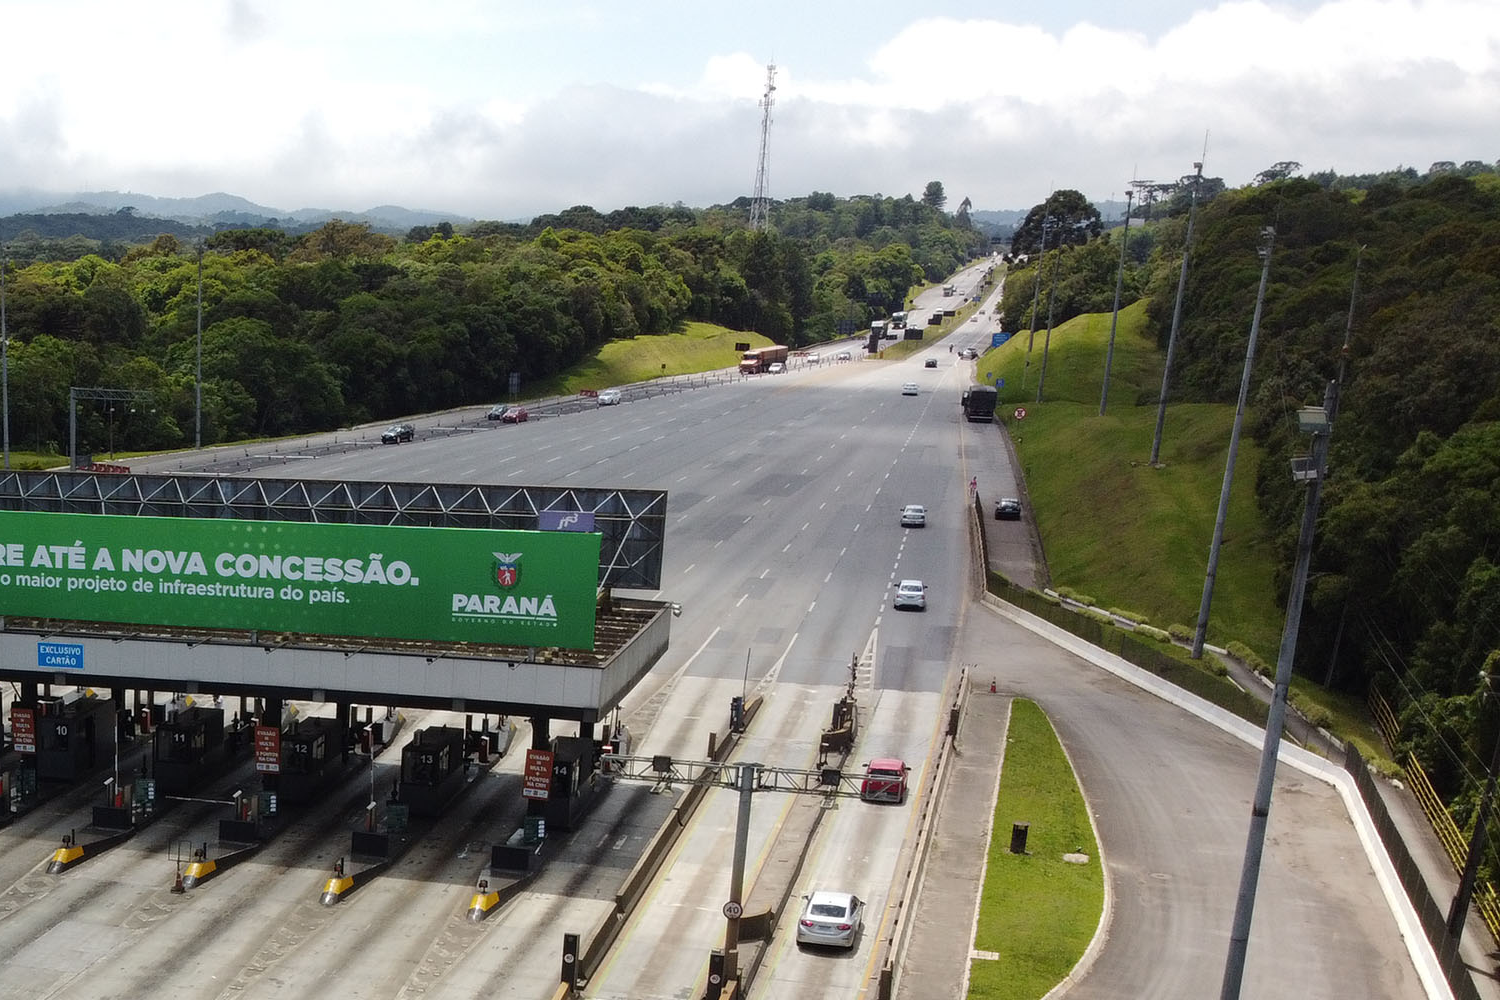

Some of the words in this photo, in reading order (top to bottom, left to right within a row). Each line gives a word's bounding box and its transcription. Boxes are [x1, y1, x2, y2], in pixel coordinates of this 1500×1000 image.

[31, 540, 85, 569] ATÉ
[92, 548, 115, 570] A
[122, 549, 207, 575] NOVA
[215, 553, 419, 585] CONCESSÃO.
[1, 574, 11, 585] o
[16, 572, 62, 588] maior
[68, 576, 127, 592] projeto
[132, 577, 153, 592] de
[159, 578, 274, 599] infraestrutura
[280, 585, 303, 600] do
[309, 587, 350, 604] país.
[452, 593, 557, 616] PARANÁ
[40, 645, 81, 656] EXCLUSIVO
[56, 725, 68, 736] 10
[173, 733, 185, 742] 11
[294, 743, 308, 753] 12
[420, 754, 434, 764] 13
[553, 766, 567, 776] 14
[726, 906, 739, 914] 40
